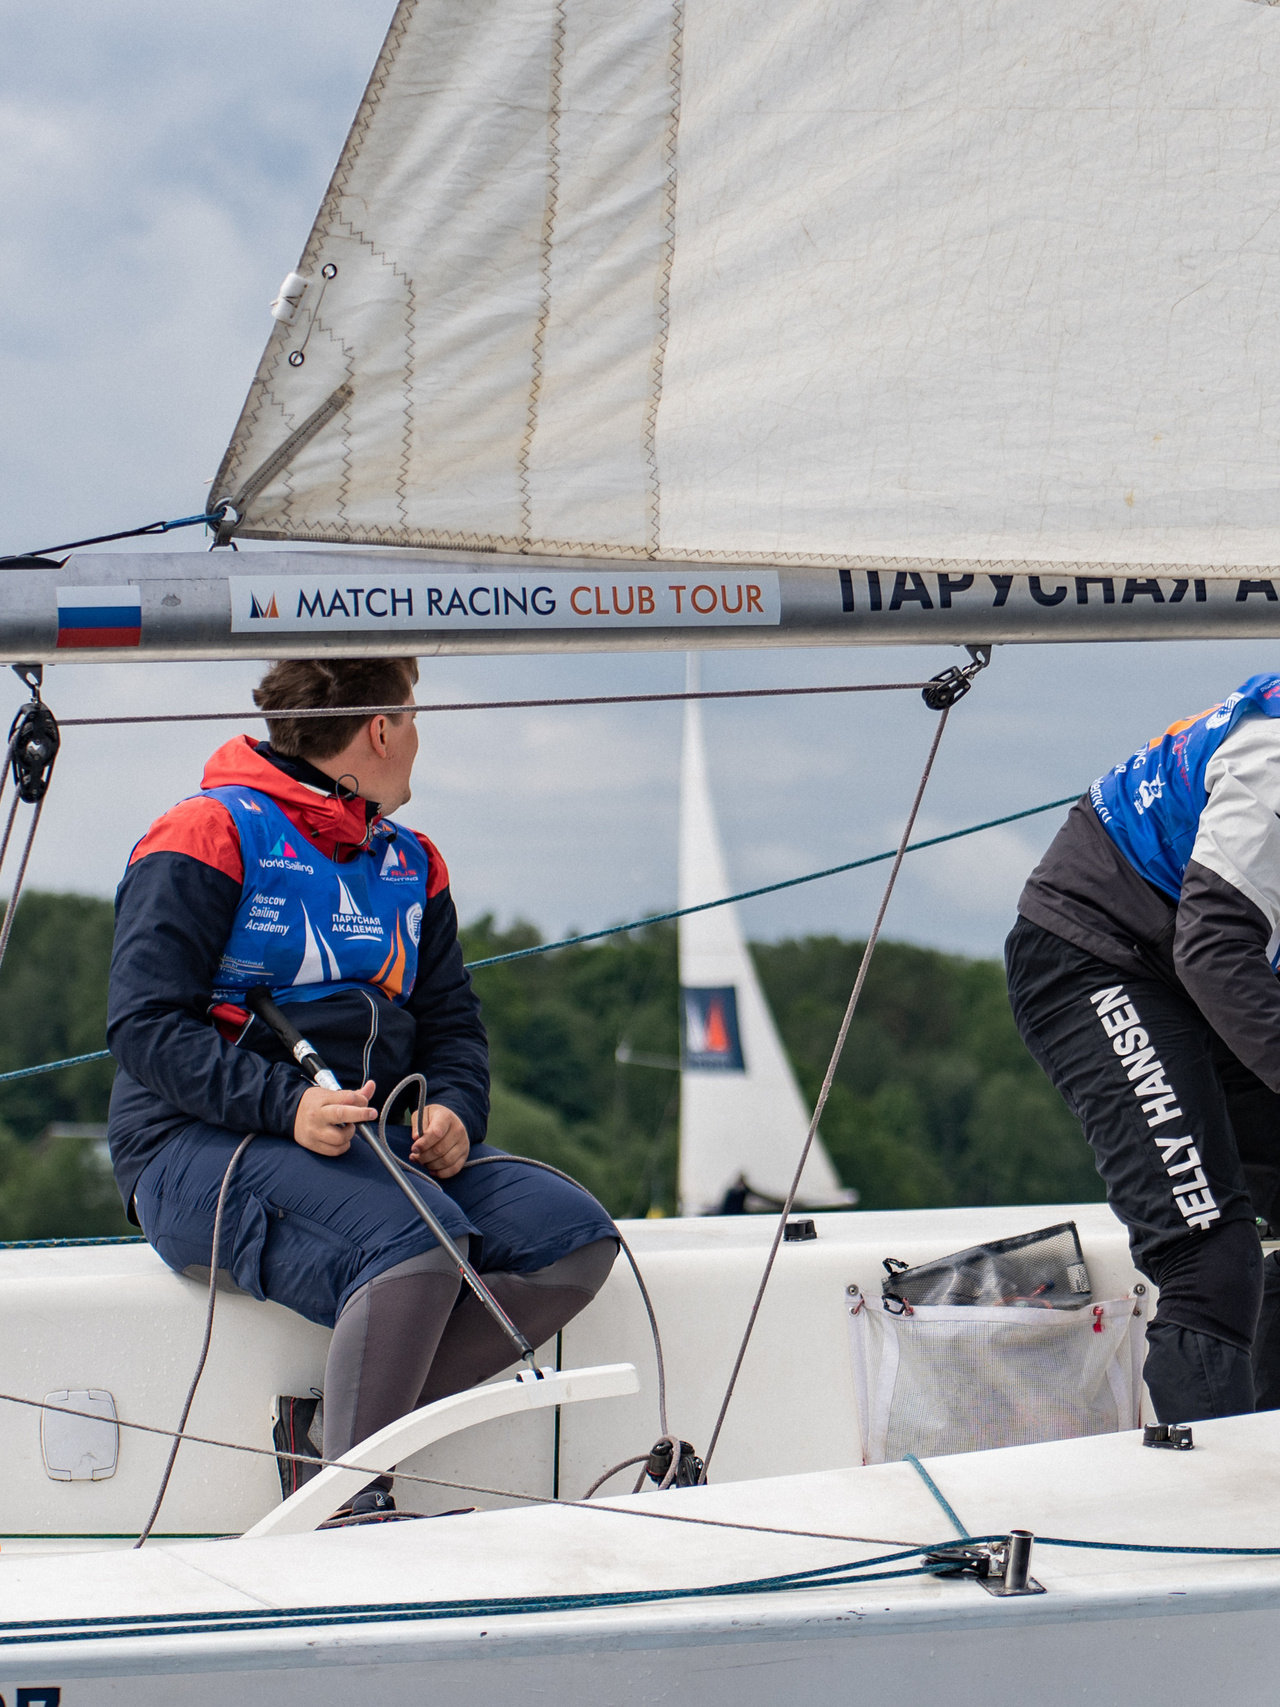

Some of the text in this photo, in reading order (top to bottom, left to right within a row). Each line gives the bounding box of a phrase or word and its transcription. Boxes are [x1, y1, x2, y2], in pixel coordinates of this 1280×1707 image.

[297, 584, 765, 618] MATCH RACING CLUB TOUR
[284, 860, 314, 875] Sailing
[252, 893, 286, 906] Moscow
[249, 905, 280, 922] Sailing
[332, 913, 381, 926] ПАРУСНАЯ
[245, 918, 290, 936] Academy
[331, 923, 384, 935] АКАДЕМИЯ
[1089, 984, 1221, 1231] HELLY HANSEN
